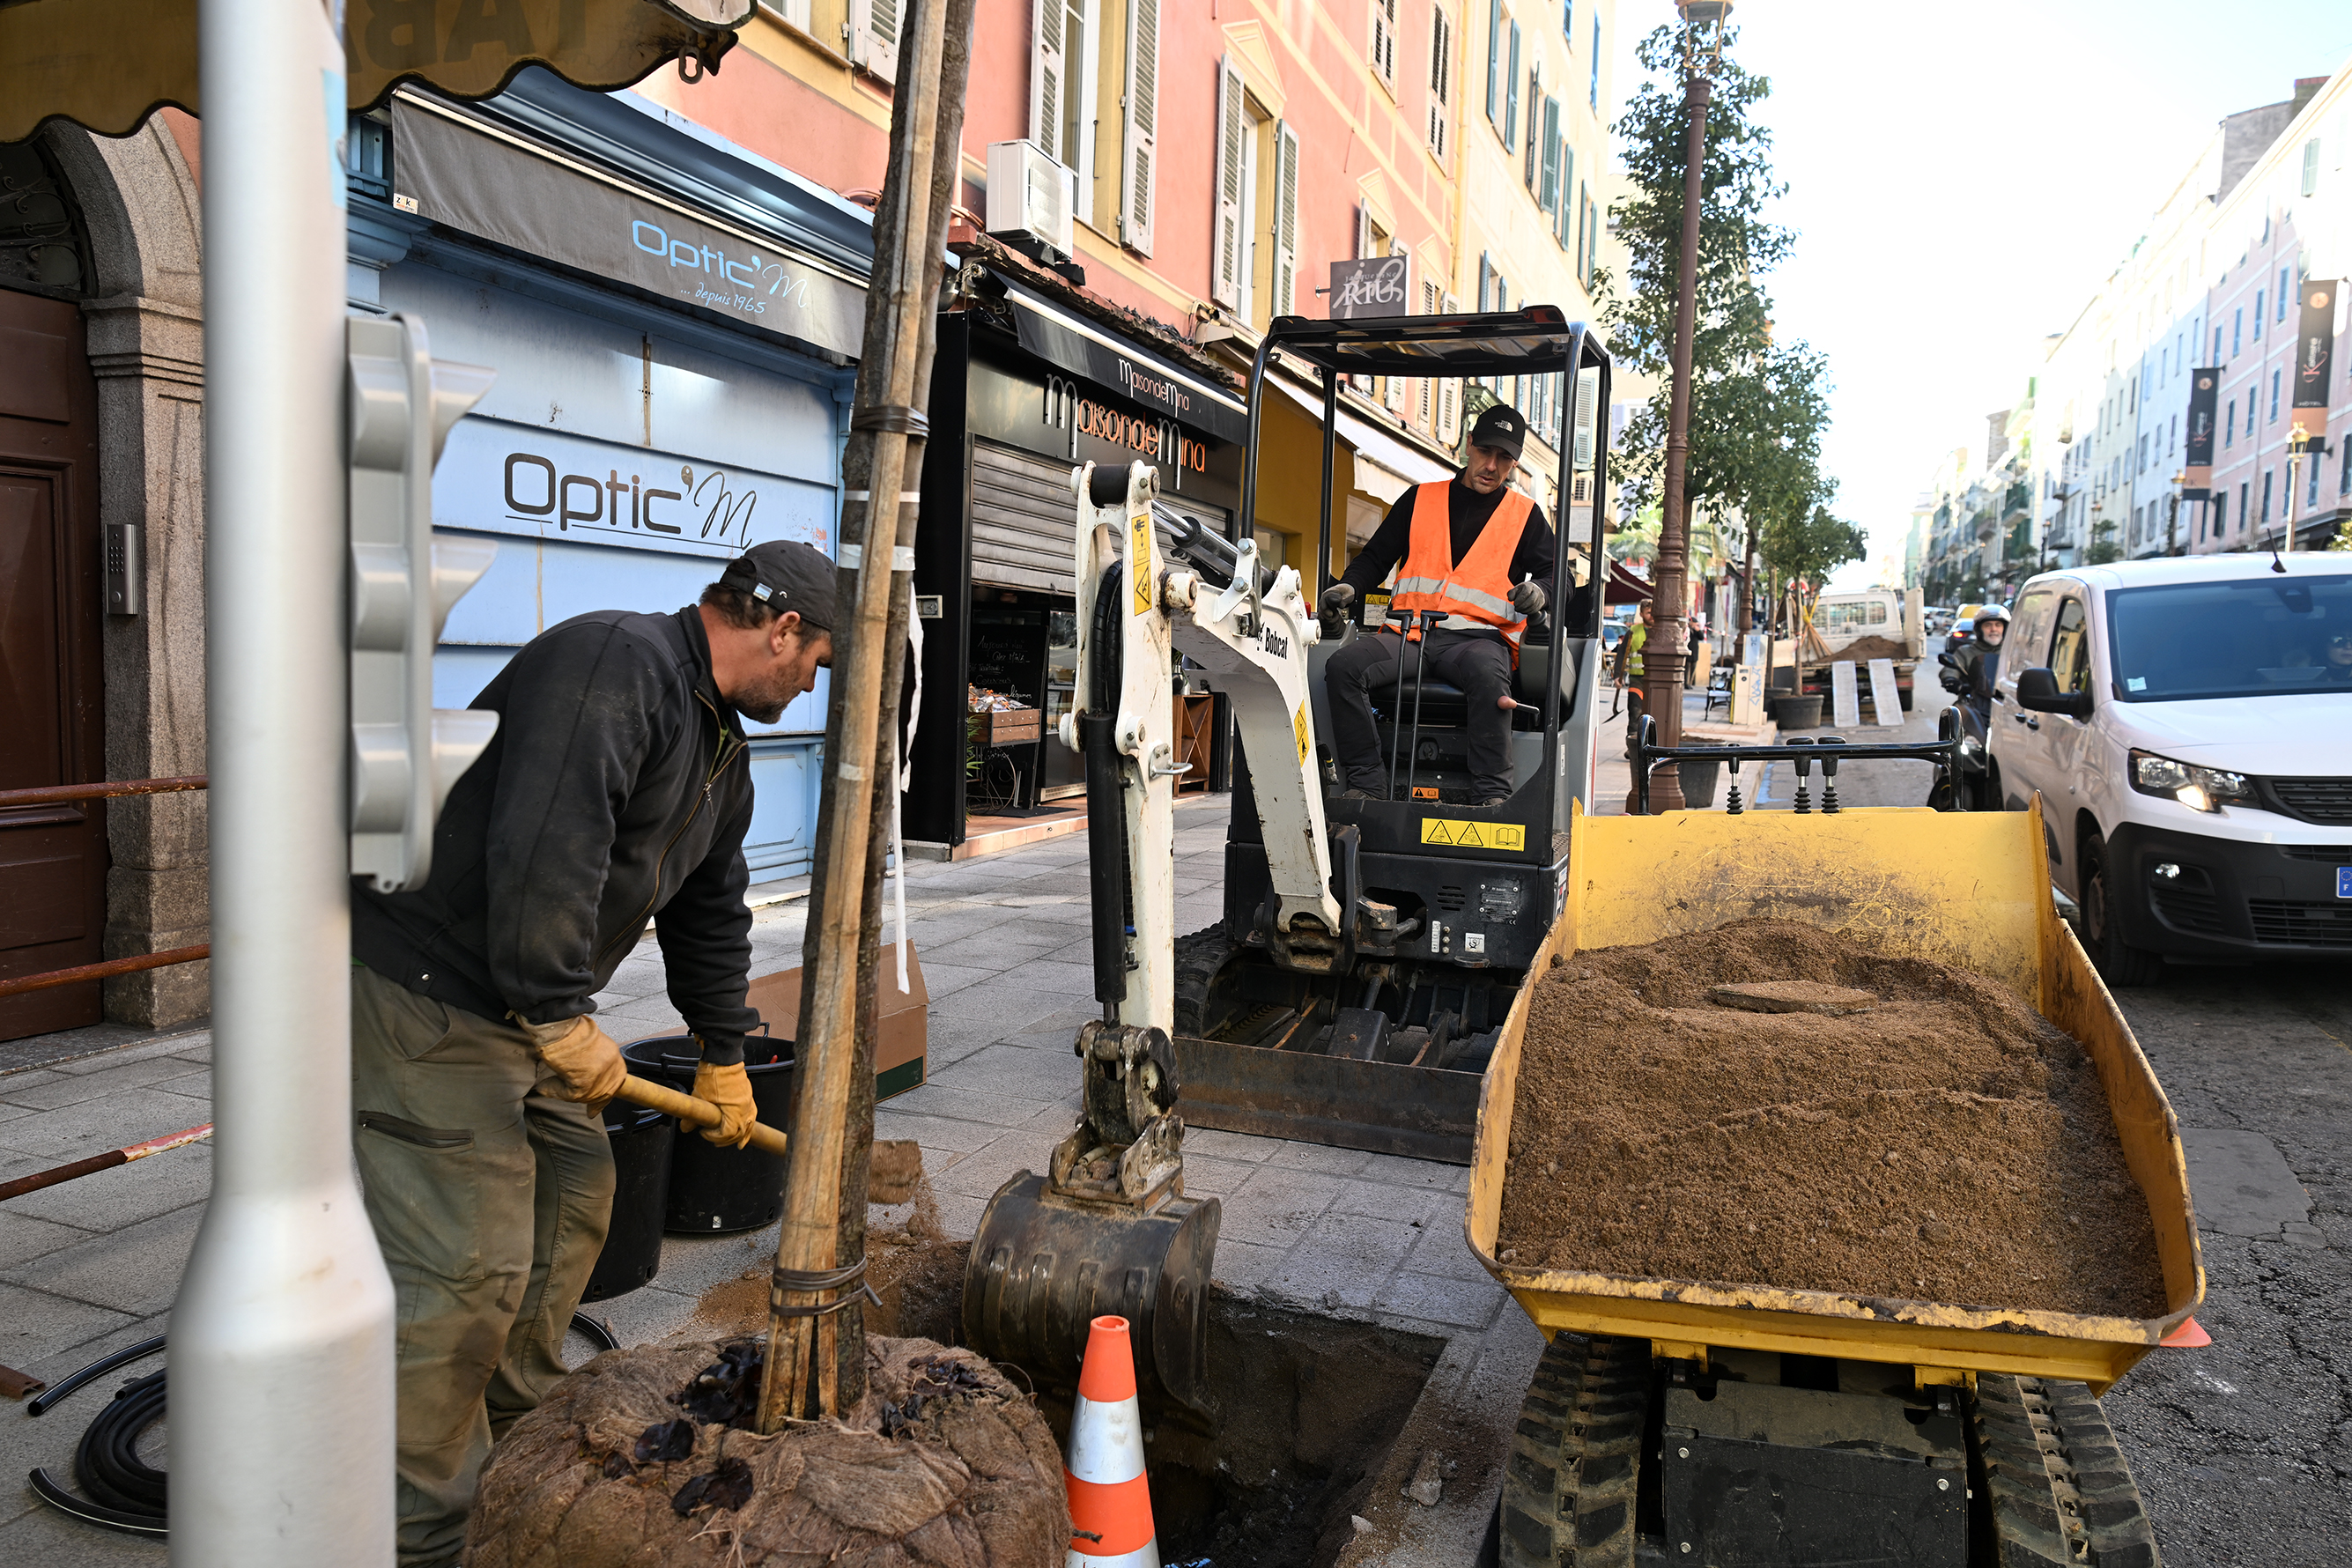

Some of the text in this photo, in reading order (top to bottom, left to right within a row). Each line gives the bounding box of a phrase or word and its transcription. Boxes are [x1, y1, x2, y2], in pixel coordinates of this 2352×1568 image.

[694, 282, 730, 307] depuis
[733, 294, 766, 314] 1965
[1342, 279, 1394, 307] RIU
[1265, 626, 1288, 660] Bobcat
